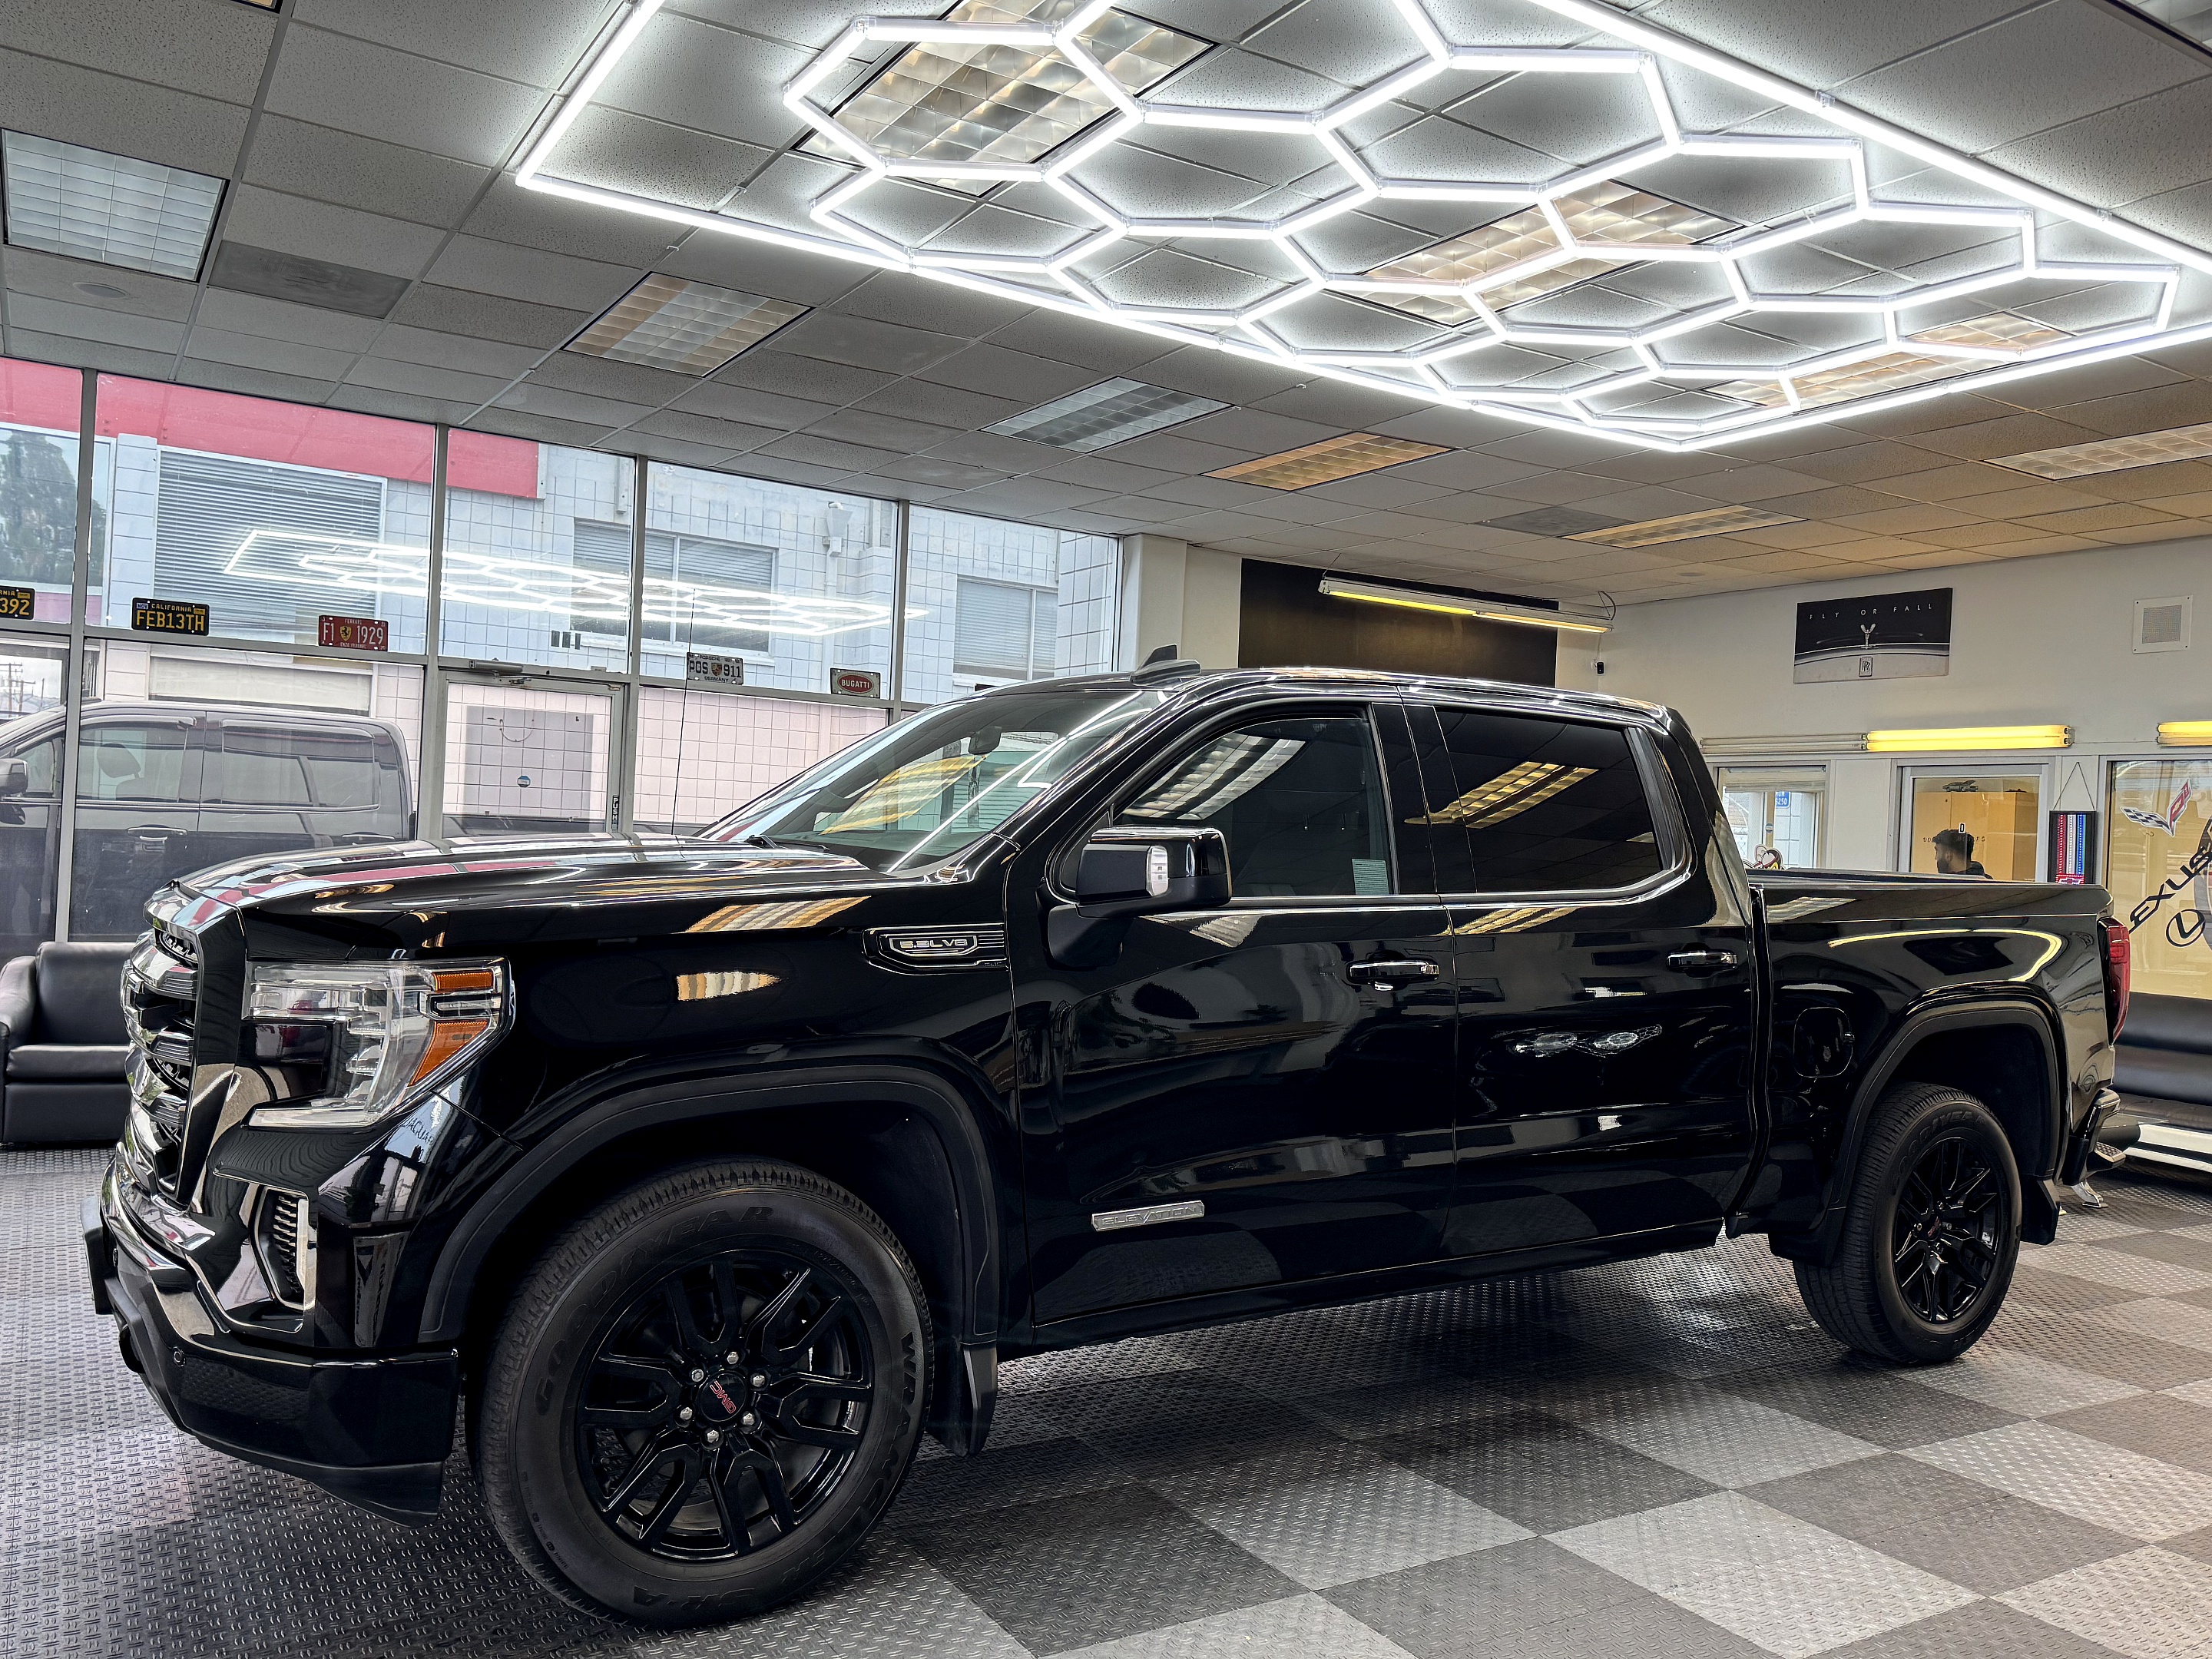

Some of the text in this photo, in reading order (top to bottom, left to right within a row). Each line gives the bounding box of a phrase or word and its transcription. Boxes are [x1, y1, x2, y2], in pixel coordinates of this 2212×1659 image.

[151, 604, 192, 612] CALIFORNIA
[1893, 603, 1932, 612] FALL
[137, 610, 204, 631] FEB13TH
[323, 618, 384, 645] F1 1929
[724, 664, 742, 678] 911
[841, 679, 869, 689] BUGATTI
[2128, 849, 2212, 935] EXUS
[1102, 1206, 1197, 1226] ELEVATION
[710, 1380, 737, 1414] GMC
